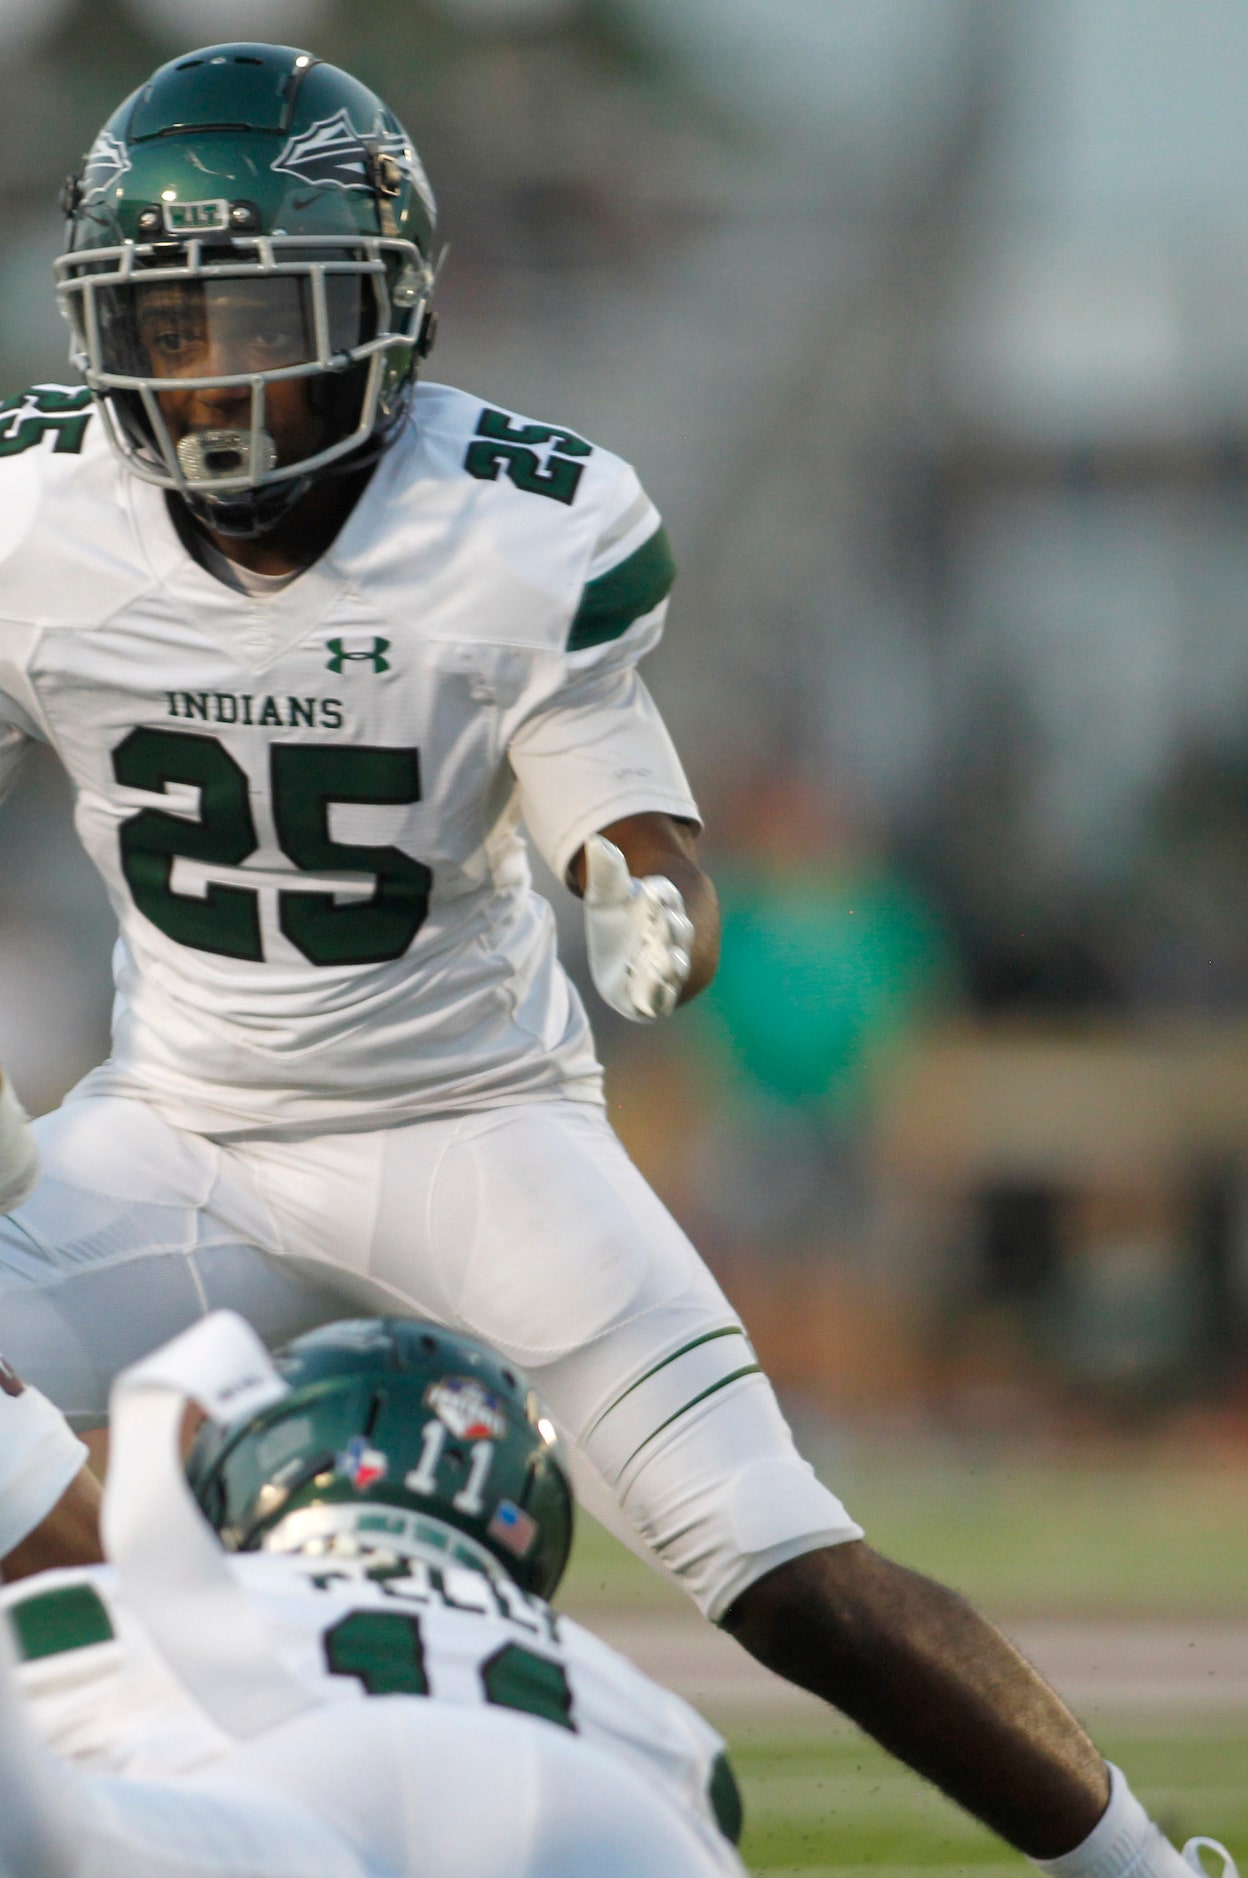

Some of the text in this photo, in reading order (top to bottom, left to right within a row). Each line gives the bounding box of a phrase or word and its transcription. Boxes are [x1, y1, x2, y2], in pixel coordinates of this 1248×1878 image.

[463, 407, 593, 507] 25
[165, 691, 344, 729] INDIANS
[111, 726, 433, 967] 25
[404, 1419, 495, 1515] 11
